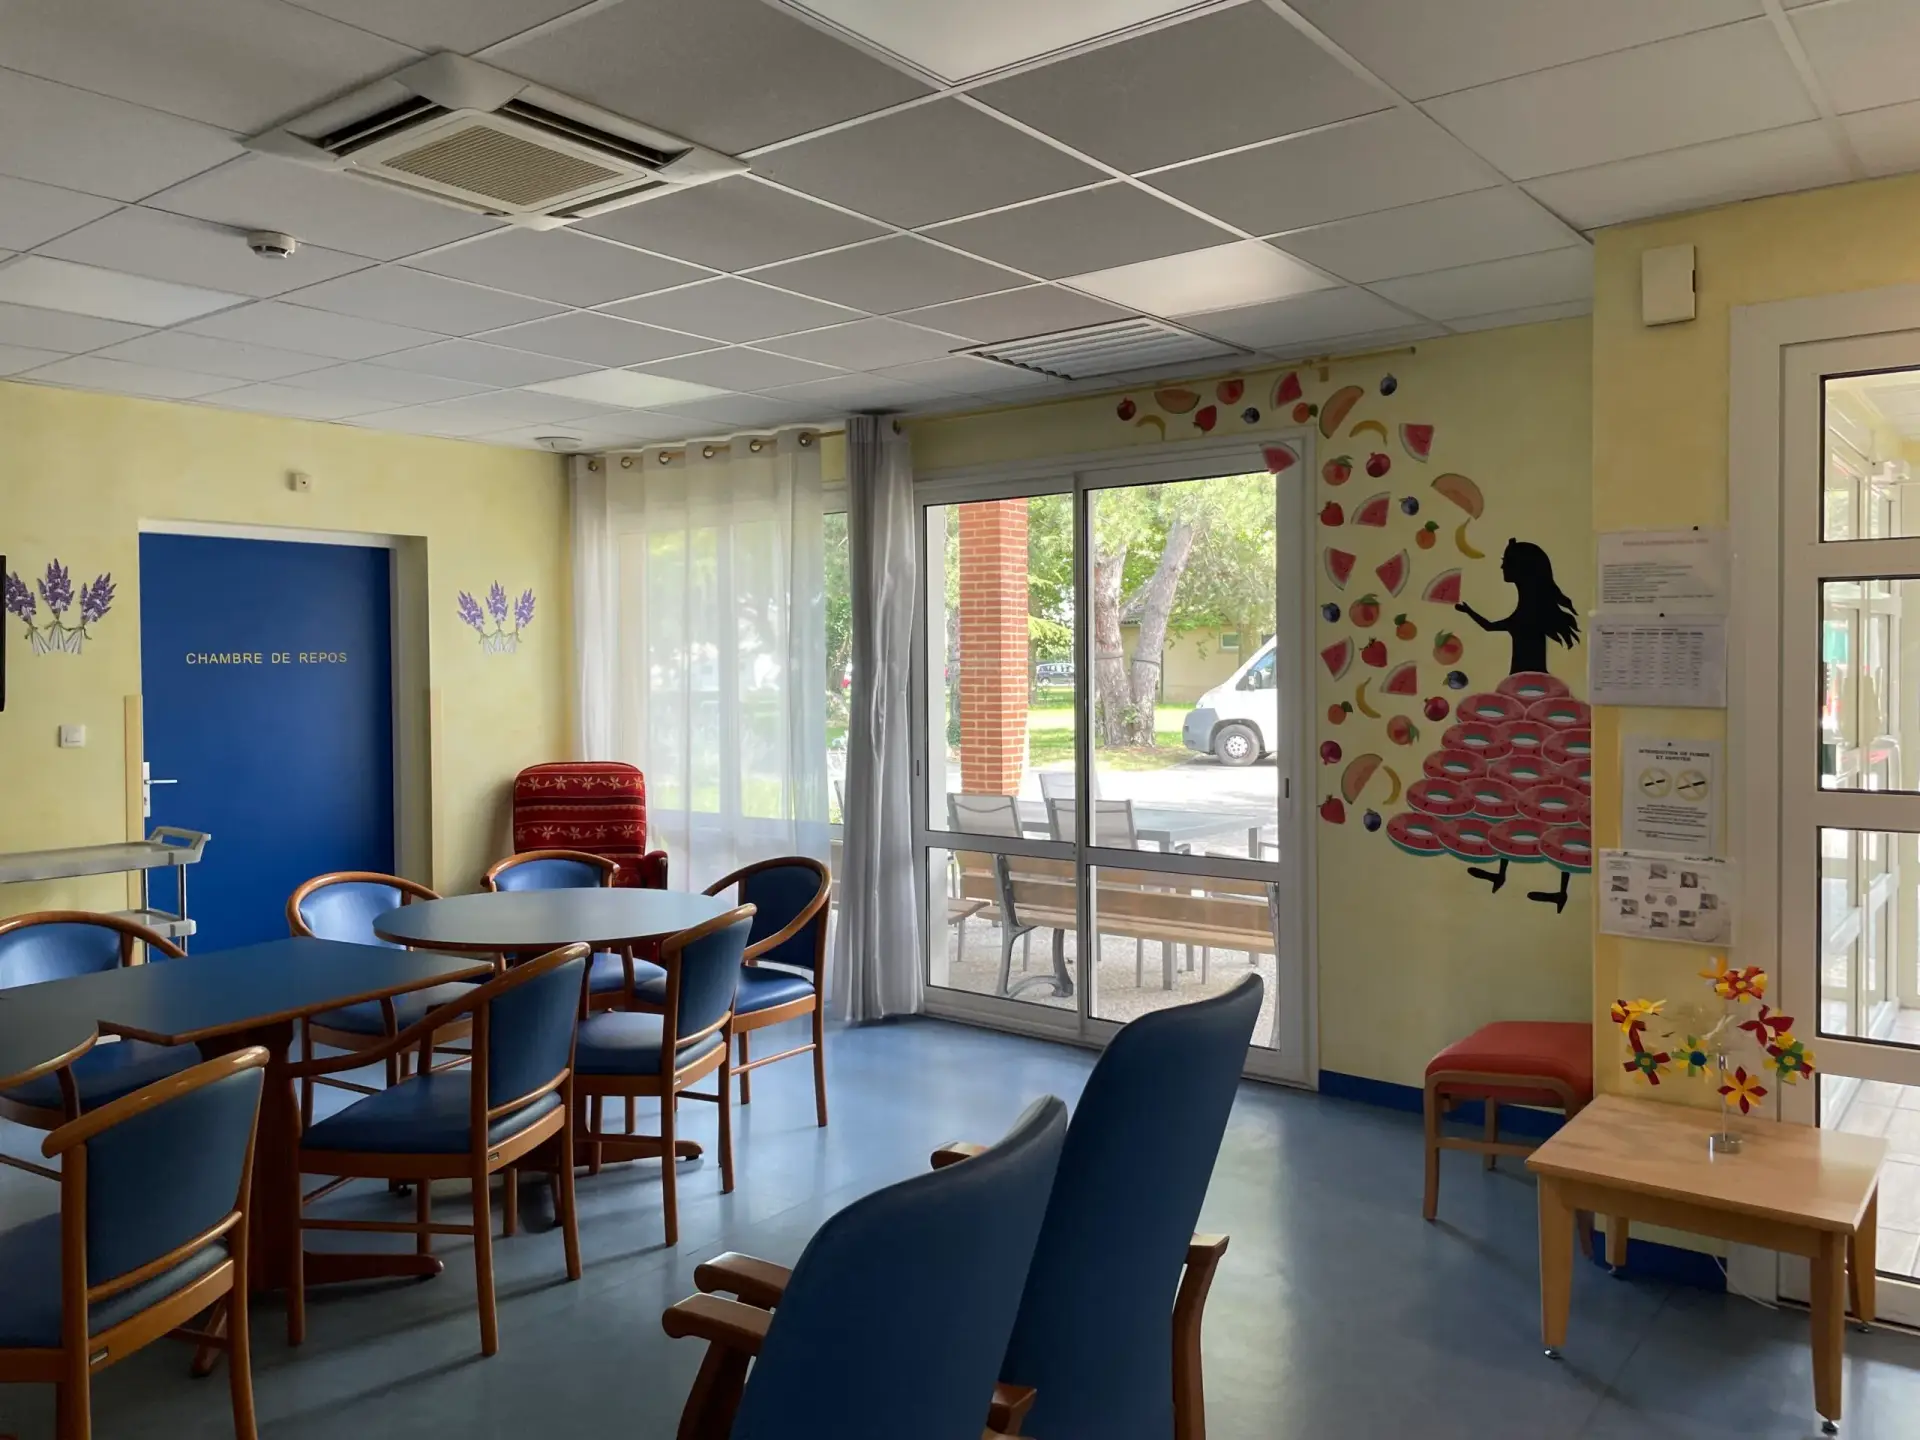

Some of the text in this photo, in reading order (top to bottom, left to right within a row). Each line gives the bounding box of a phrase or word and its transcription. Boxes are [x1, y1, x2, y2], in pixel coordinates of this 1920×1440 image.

[186, 652, 348, 665] CHAMBRE DE REPOS
